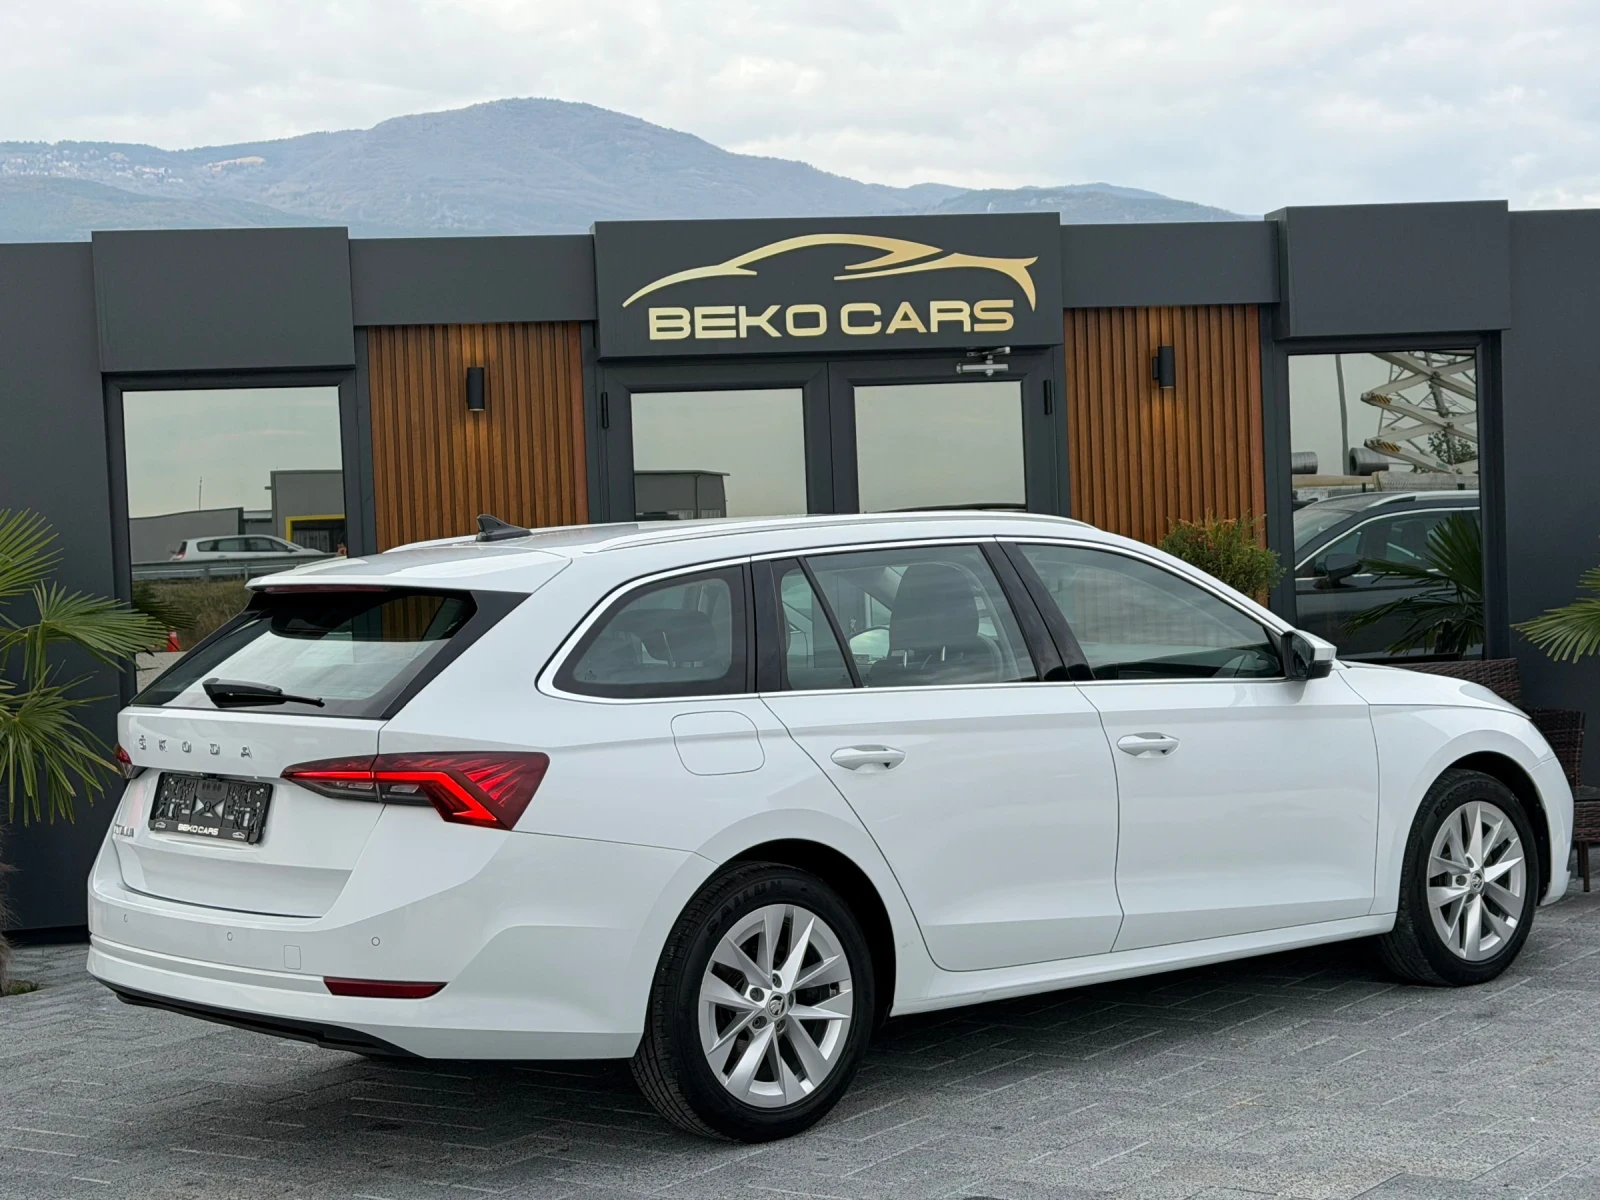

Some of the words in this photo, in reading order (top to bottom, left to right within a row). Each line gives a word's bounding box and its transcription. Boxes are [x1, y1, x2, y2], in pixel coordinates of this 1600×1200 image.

[648, 303, 828, 341] BEKO
[839, 299, 1015, 336] CARS
[177, 823, 198, 833] BEKO
[198, 825, 219, 836] CARS
[706, 879, 783, 936] SAILUN
